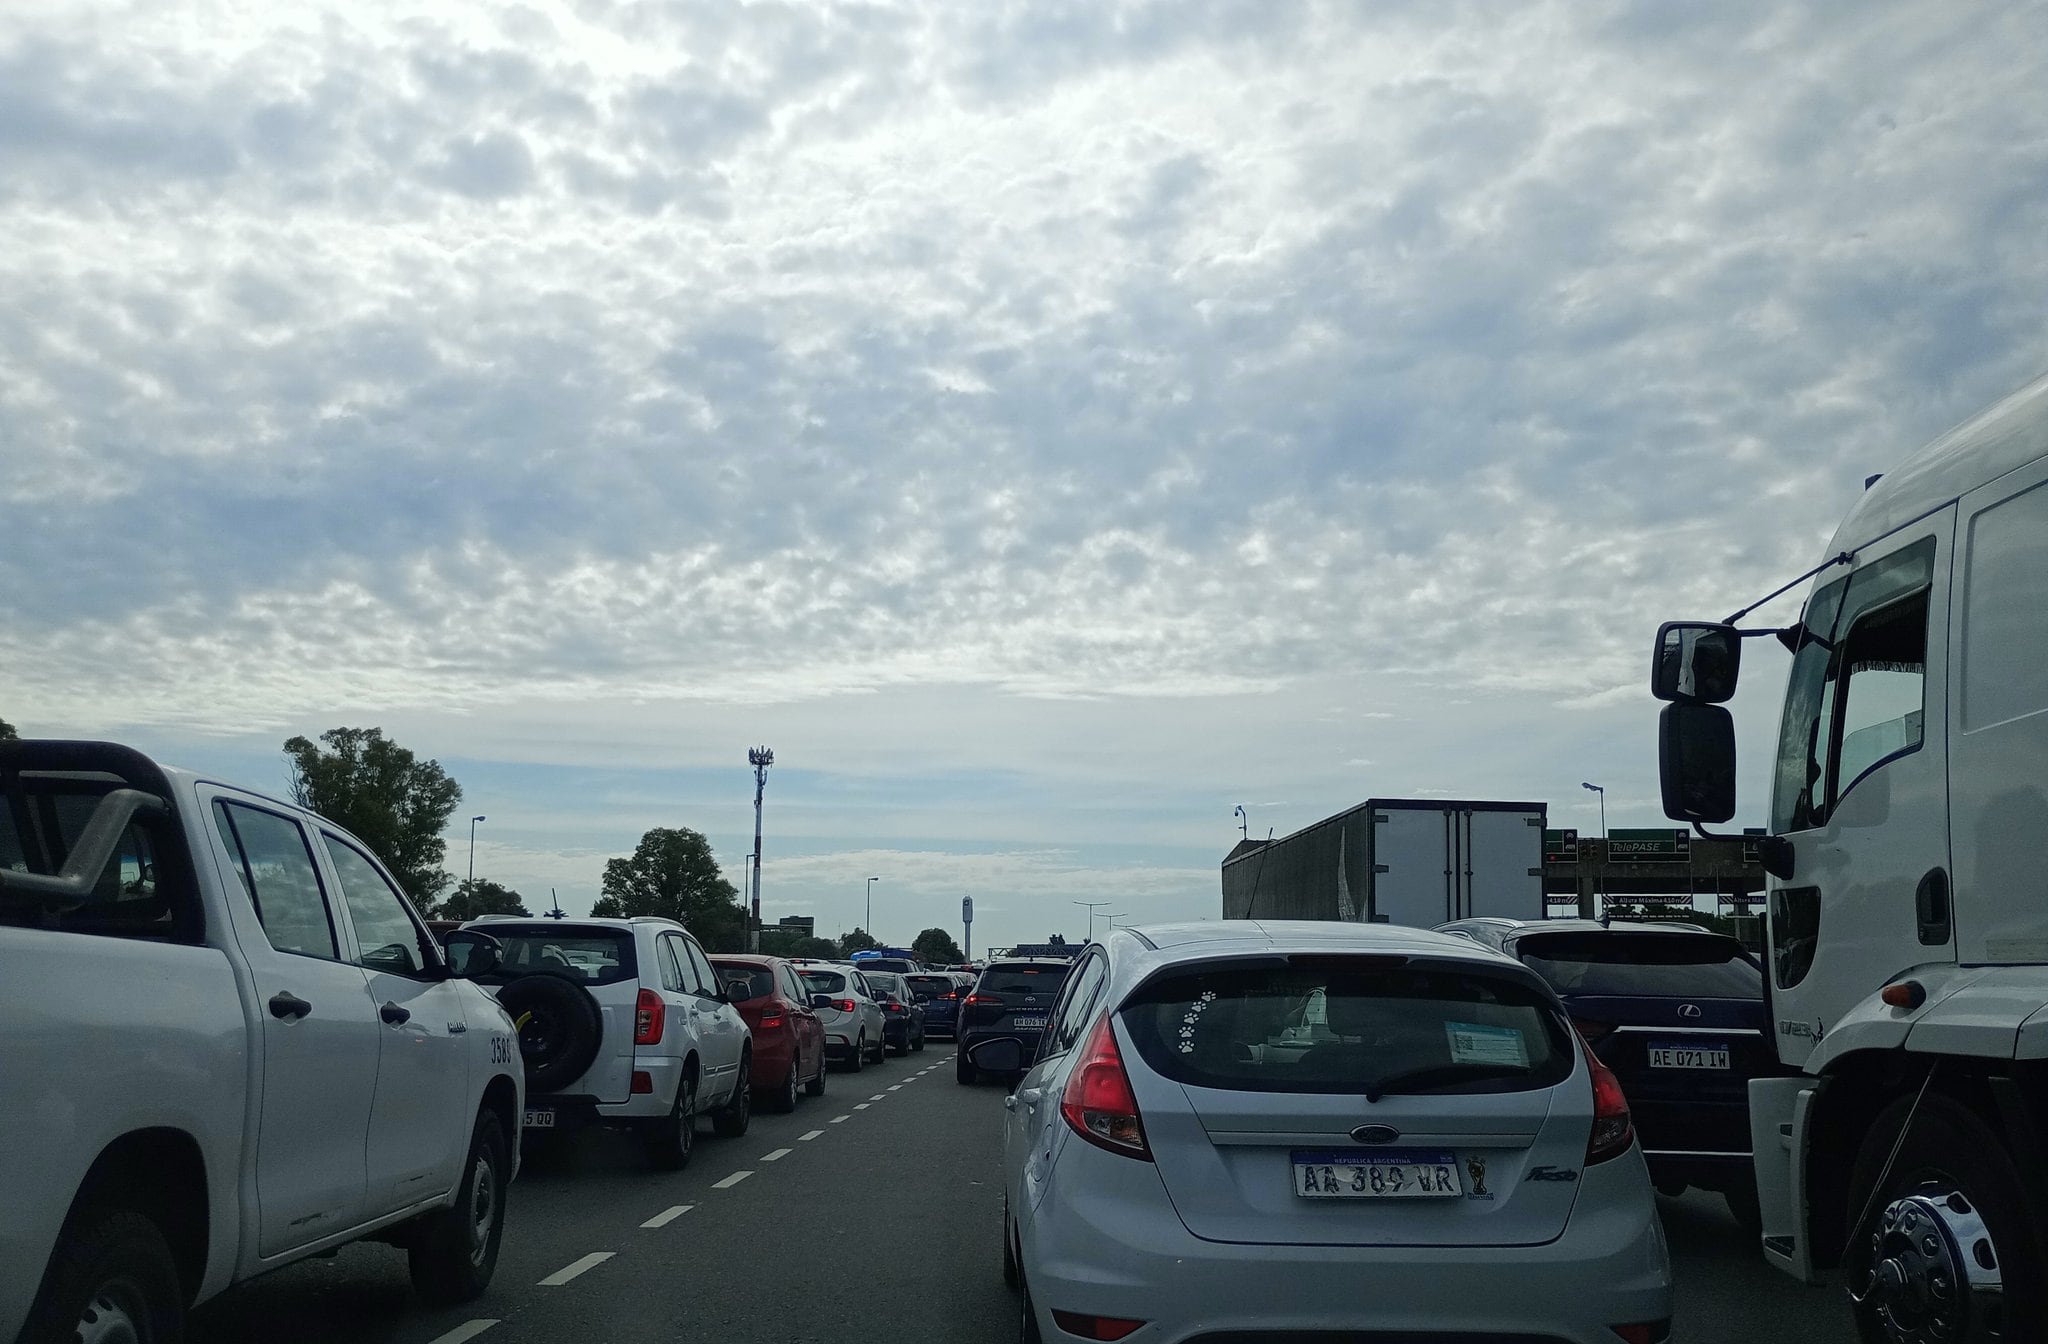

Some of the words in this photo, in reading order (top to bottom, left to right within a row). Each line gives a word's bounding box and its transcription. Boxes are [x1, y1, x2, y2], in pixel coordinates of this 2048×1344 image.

[1612, 843, 1661, 851] TelePASE
[1619, 896, 1637, 904] Altura
[1653, 1050, 1672, 1066] AE
[1676, 1051, 1704, 1067] 071
[1709, 1052, 1726, 1067] IW
[536, 1112, 552, 1125] QQ
